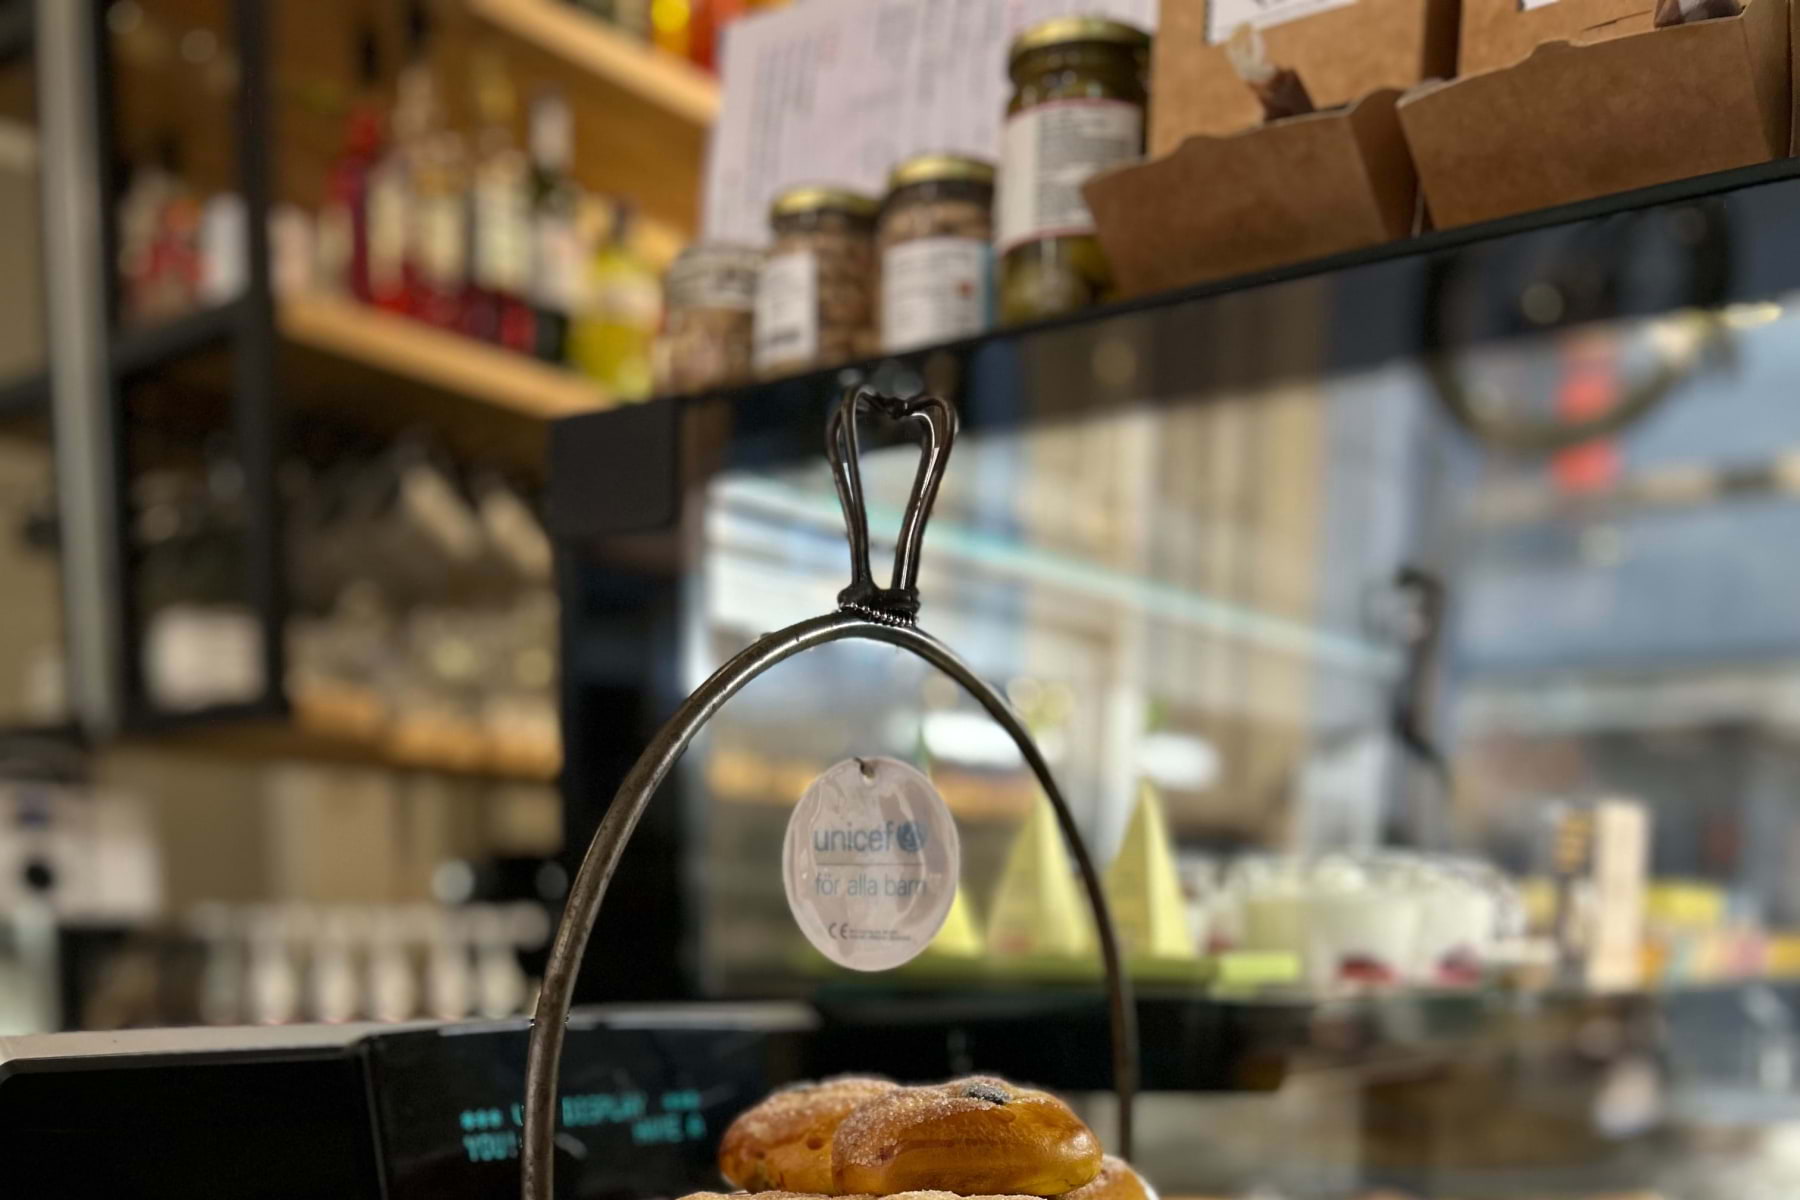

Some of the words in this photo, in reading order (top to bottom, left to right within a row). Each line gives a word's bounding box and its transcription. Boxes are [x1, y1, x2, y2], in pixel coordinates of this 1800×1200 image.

[813, 821, 895, 852] unicef
[815, 873, 839, 896] för
[847, 872, 878, 896] alla
[884, 872, 927, 897] barn
